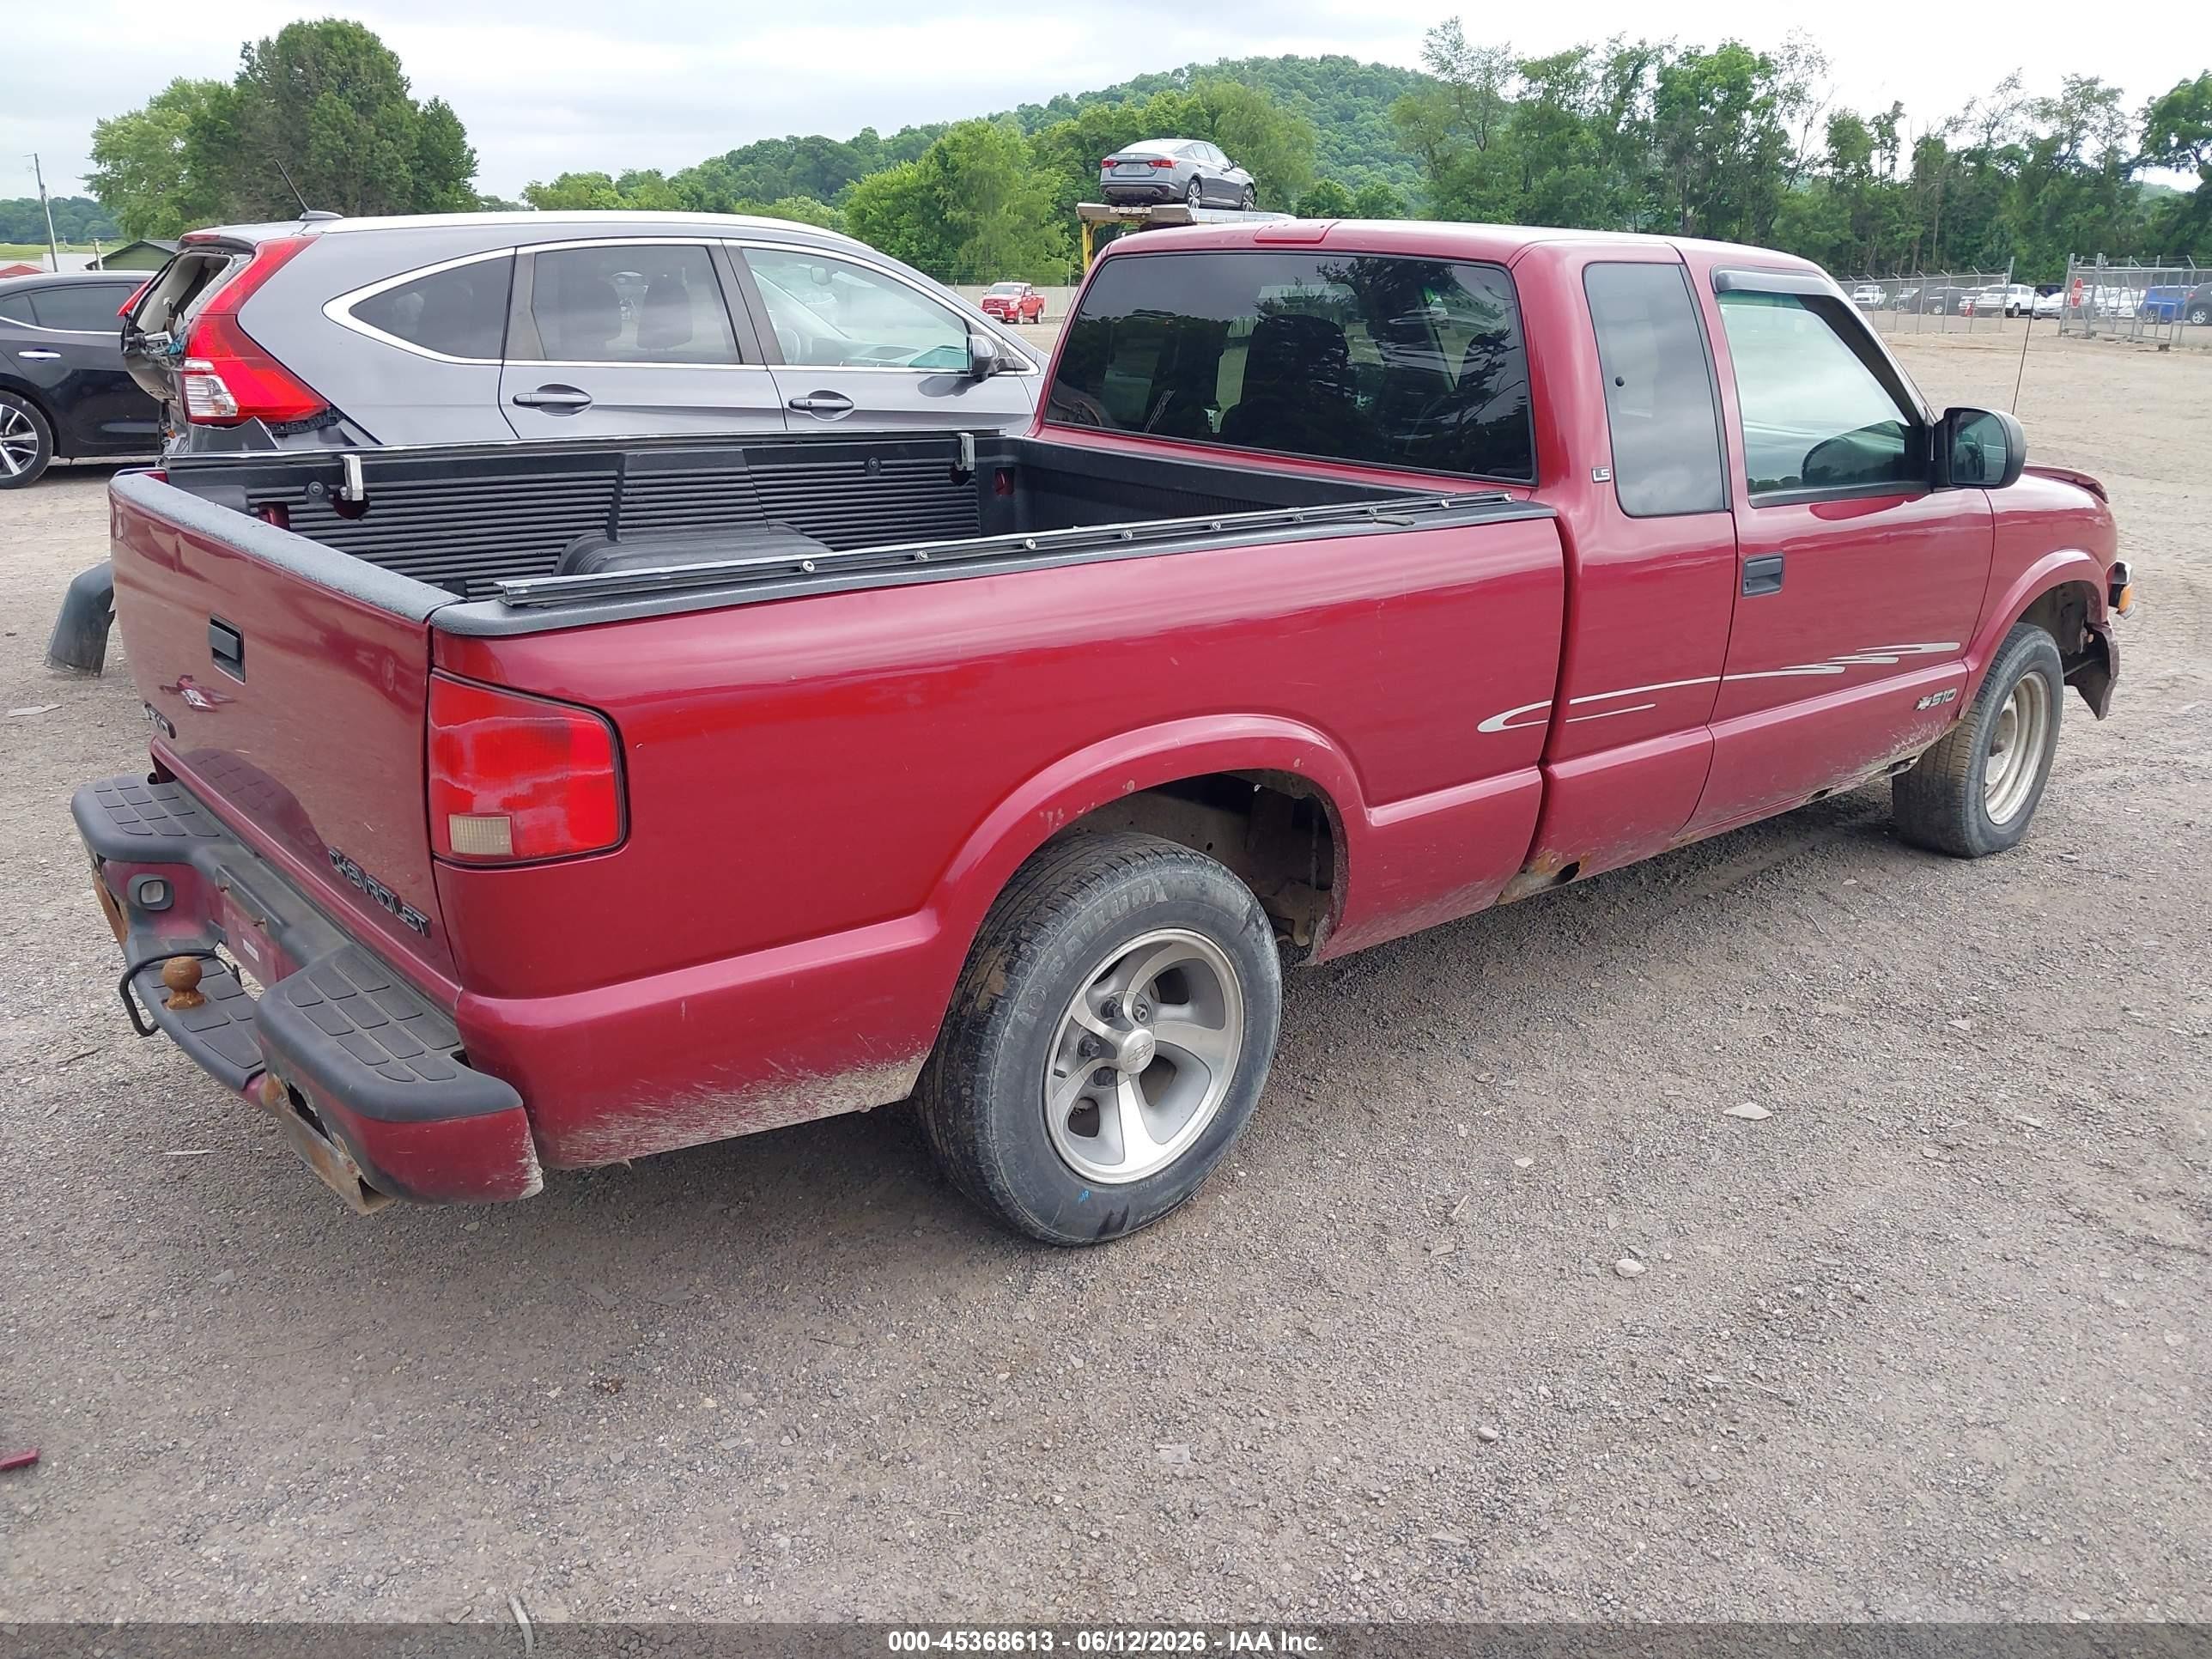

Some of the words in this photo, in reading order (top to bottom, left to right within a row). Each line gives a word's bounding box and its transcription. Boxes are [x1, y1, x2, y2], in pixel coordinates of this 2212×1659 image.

[1592, 468, 1611, 482] LS
[1929, 687, 1958, 708] S10
[328, 847, 431, 938] CHEVROLET
